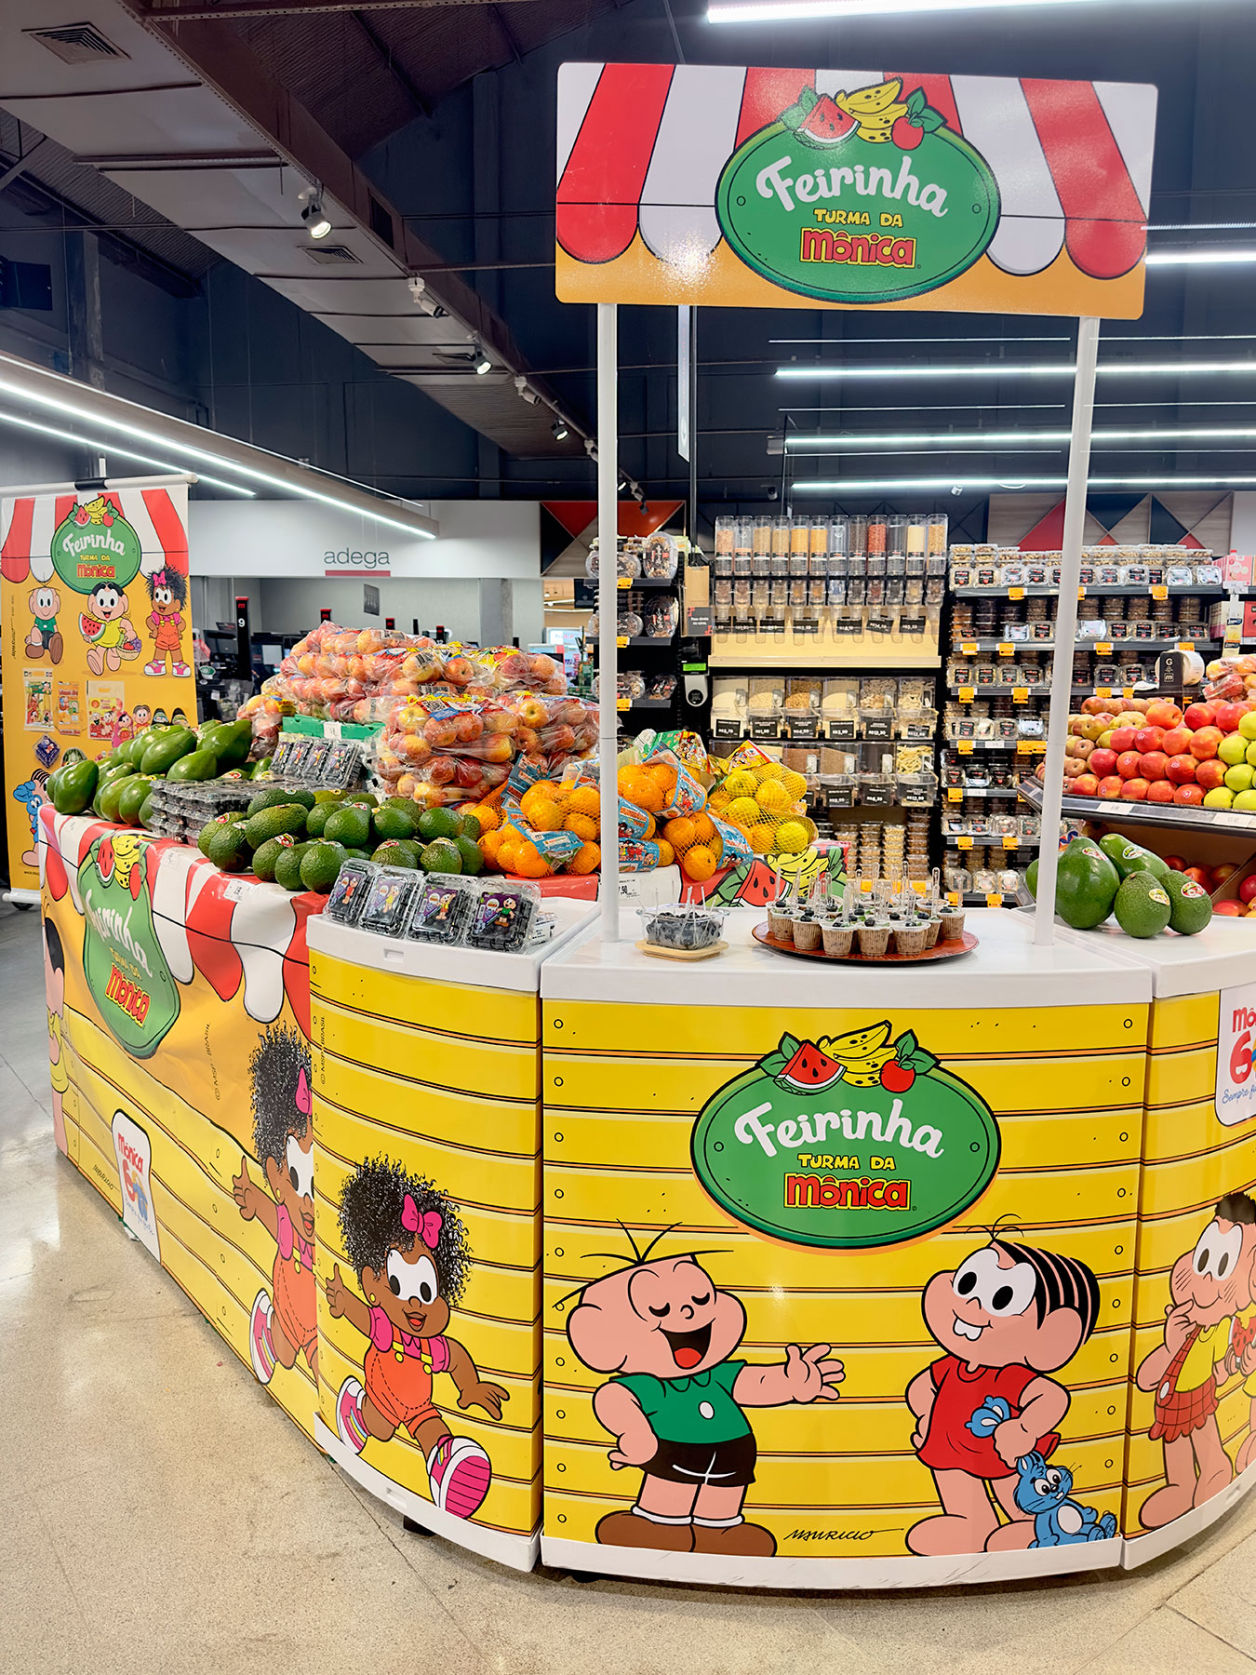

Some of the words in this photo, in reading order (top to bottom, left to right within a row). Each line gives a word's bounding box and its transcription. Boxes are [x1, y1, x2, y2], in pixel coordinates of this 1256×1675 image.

[756, 155, 948, 217] Feirinha
[813, 207, 871, 226] TURMA
[879, 211, 904, 228] DA
[62, 528, 126, 557] Feirinha
[323, 547, 391, 569] adega
[238, 617, 246, 628] 9
[734, 1098, 945, 1158] Feirinha
[797, 1153, 861, 1170] TURMA
[870, 1155, 896, 1171] DA
